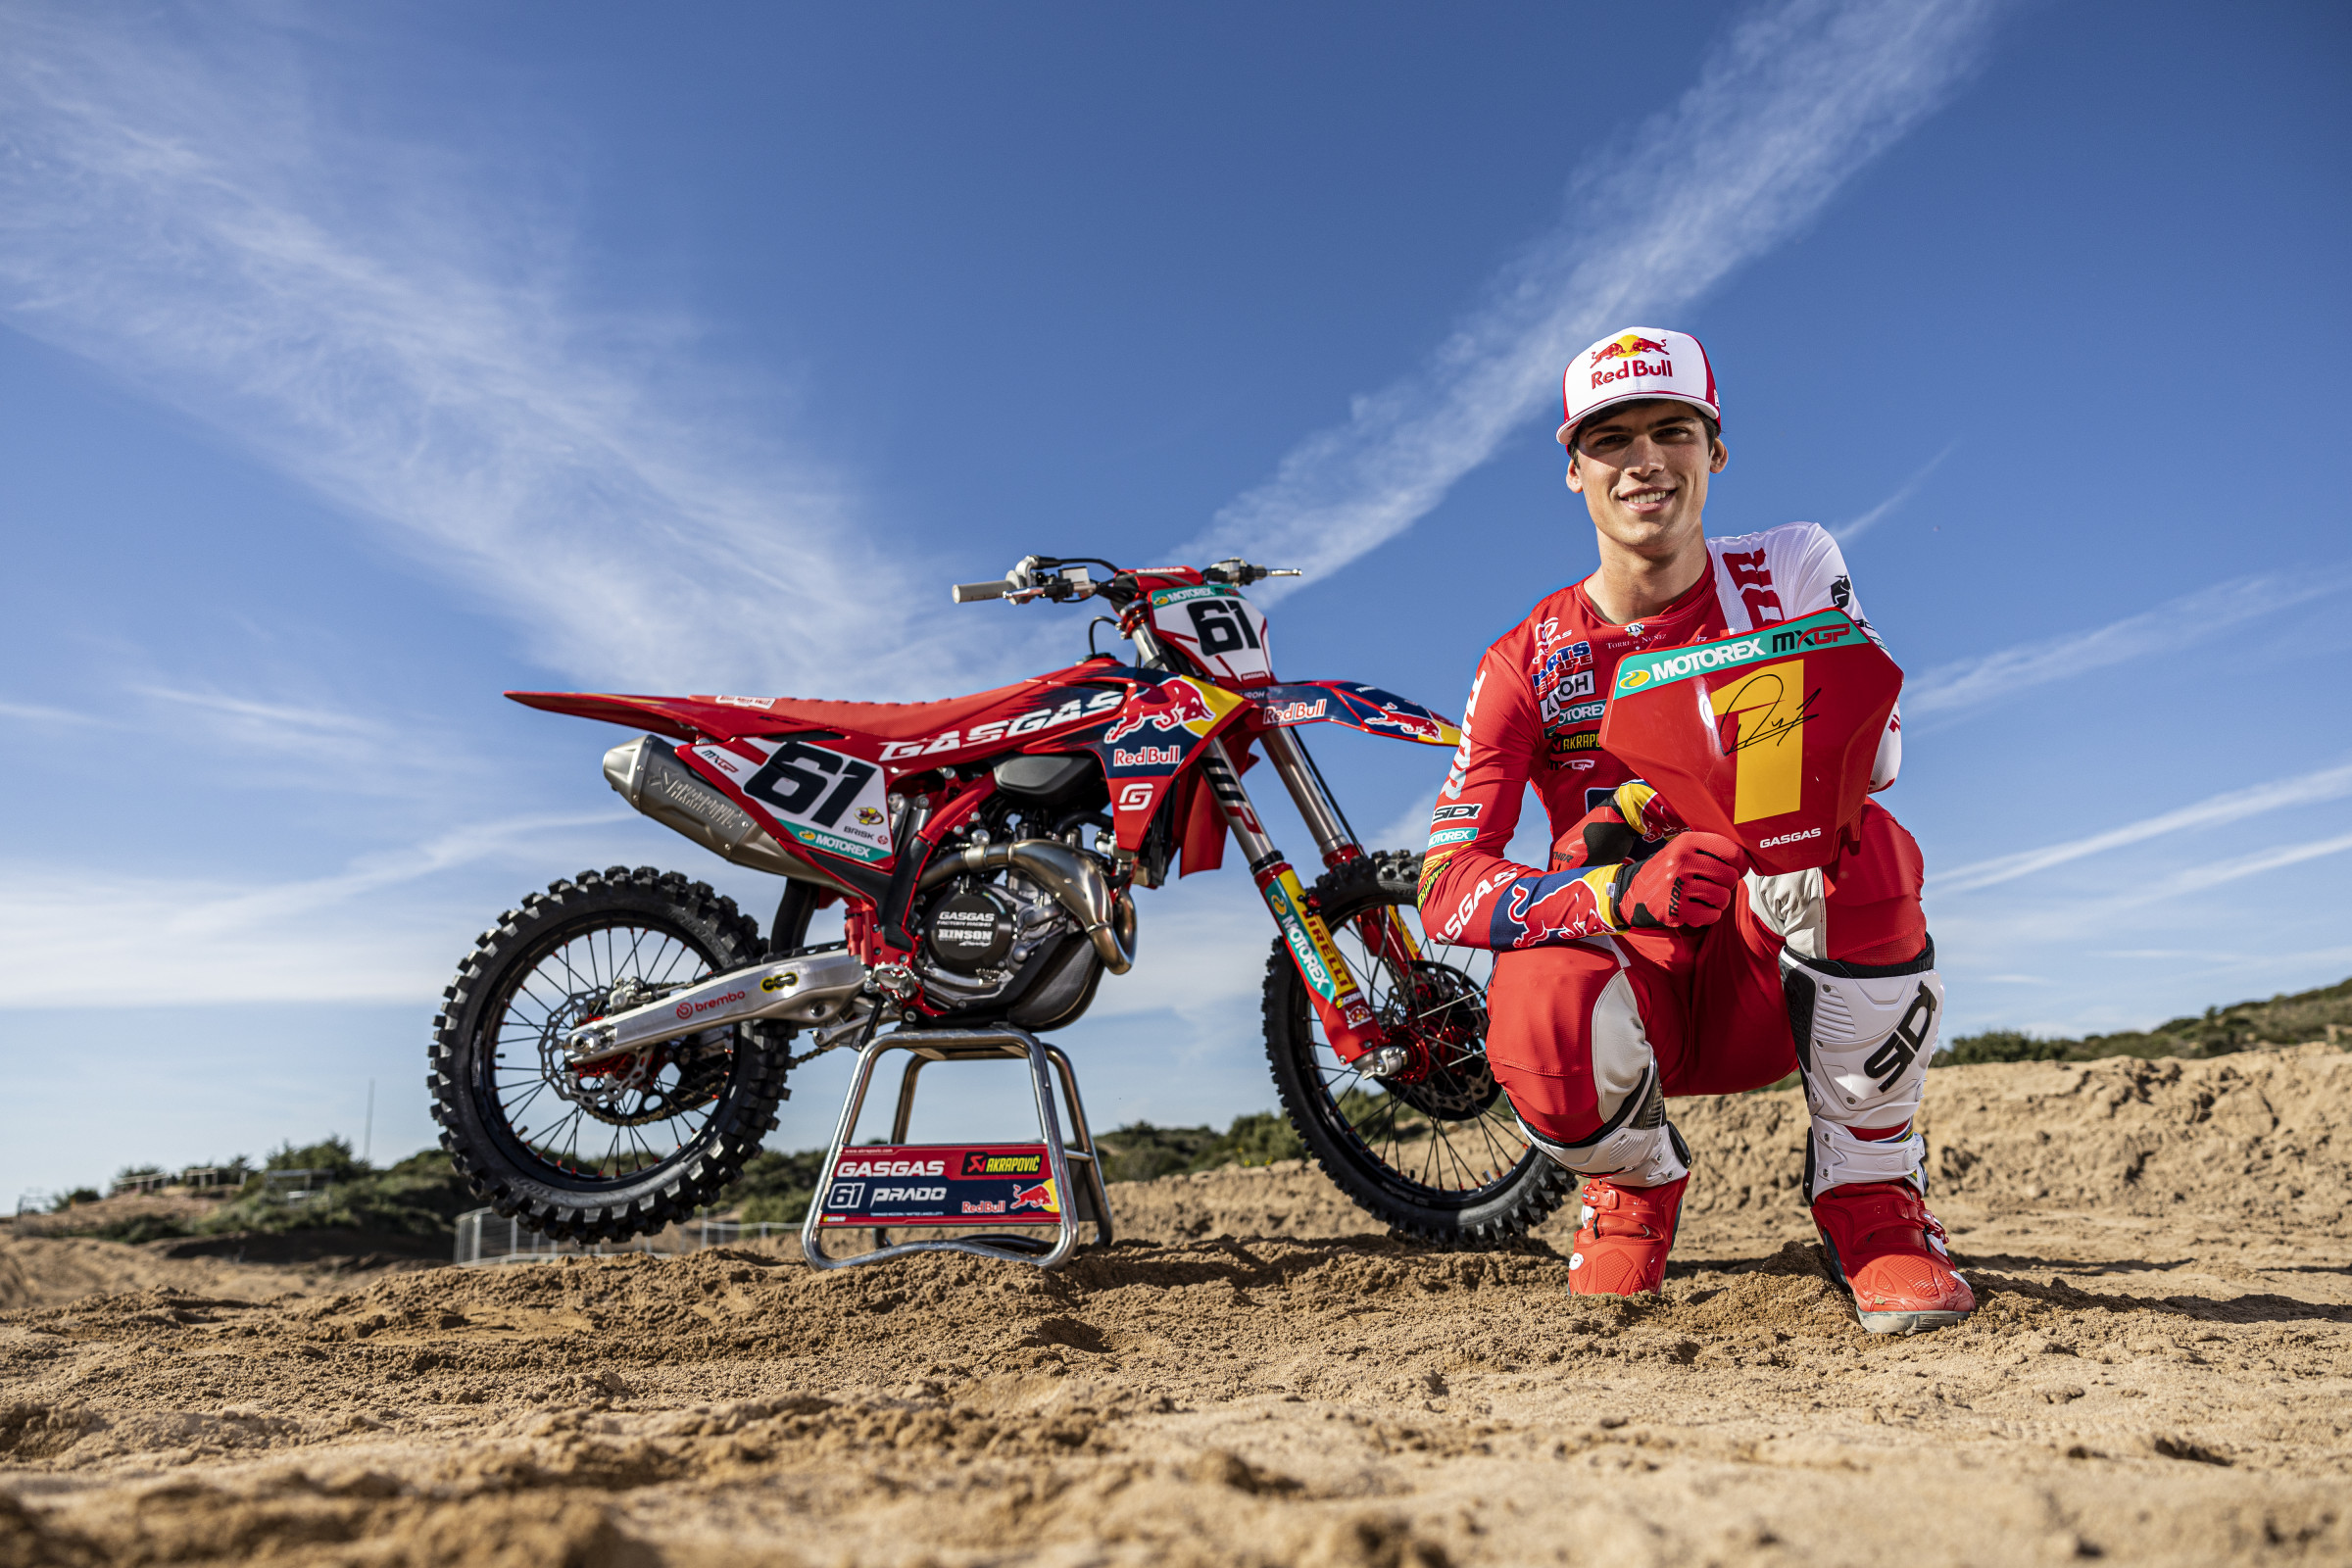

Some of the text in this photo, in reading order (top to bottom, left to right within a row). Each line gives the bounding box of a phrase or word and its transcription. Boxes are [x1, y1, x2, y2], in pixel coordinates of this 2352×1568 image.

[1591, 359, 1674, 389] Red Bull
[1167, 587, 1215, 603] MOTOREX
[1187, 600, 1260, 657] 61
[1650, 638, 1767, 683] MOTOREX
[1772, 623, 1851, 654] MXGP
[1263, 698, 1328, 724] Red Bull
[1558, 703, 1607, 724] OTOREX
[878, 690, 1125, 761] GASGAS
[1710, 659, 1804, 825] 1
[1114, 746, 1180, 767] Red Bull
[743, 741, 877, 829] 61
[815, 834, 870, 858] MOTOREX
[844, 826, 875, 841] BRISK
[1759, 827, 1823, 850] GASGAS
[1668, 876, 1685, 918] THOR
[939, 911, 995, 922] GASGAS
[938, 928, 993, 941] HINSON
[1282, 915, 1332, 990] MOTOREX
[694, 990, 746, 1012] brembo
[836, 1160, 946, 1177] GASGAS
[827, 1182, 1006, 1214] 61 PRADO Red Bull
